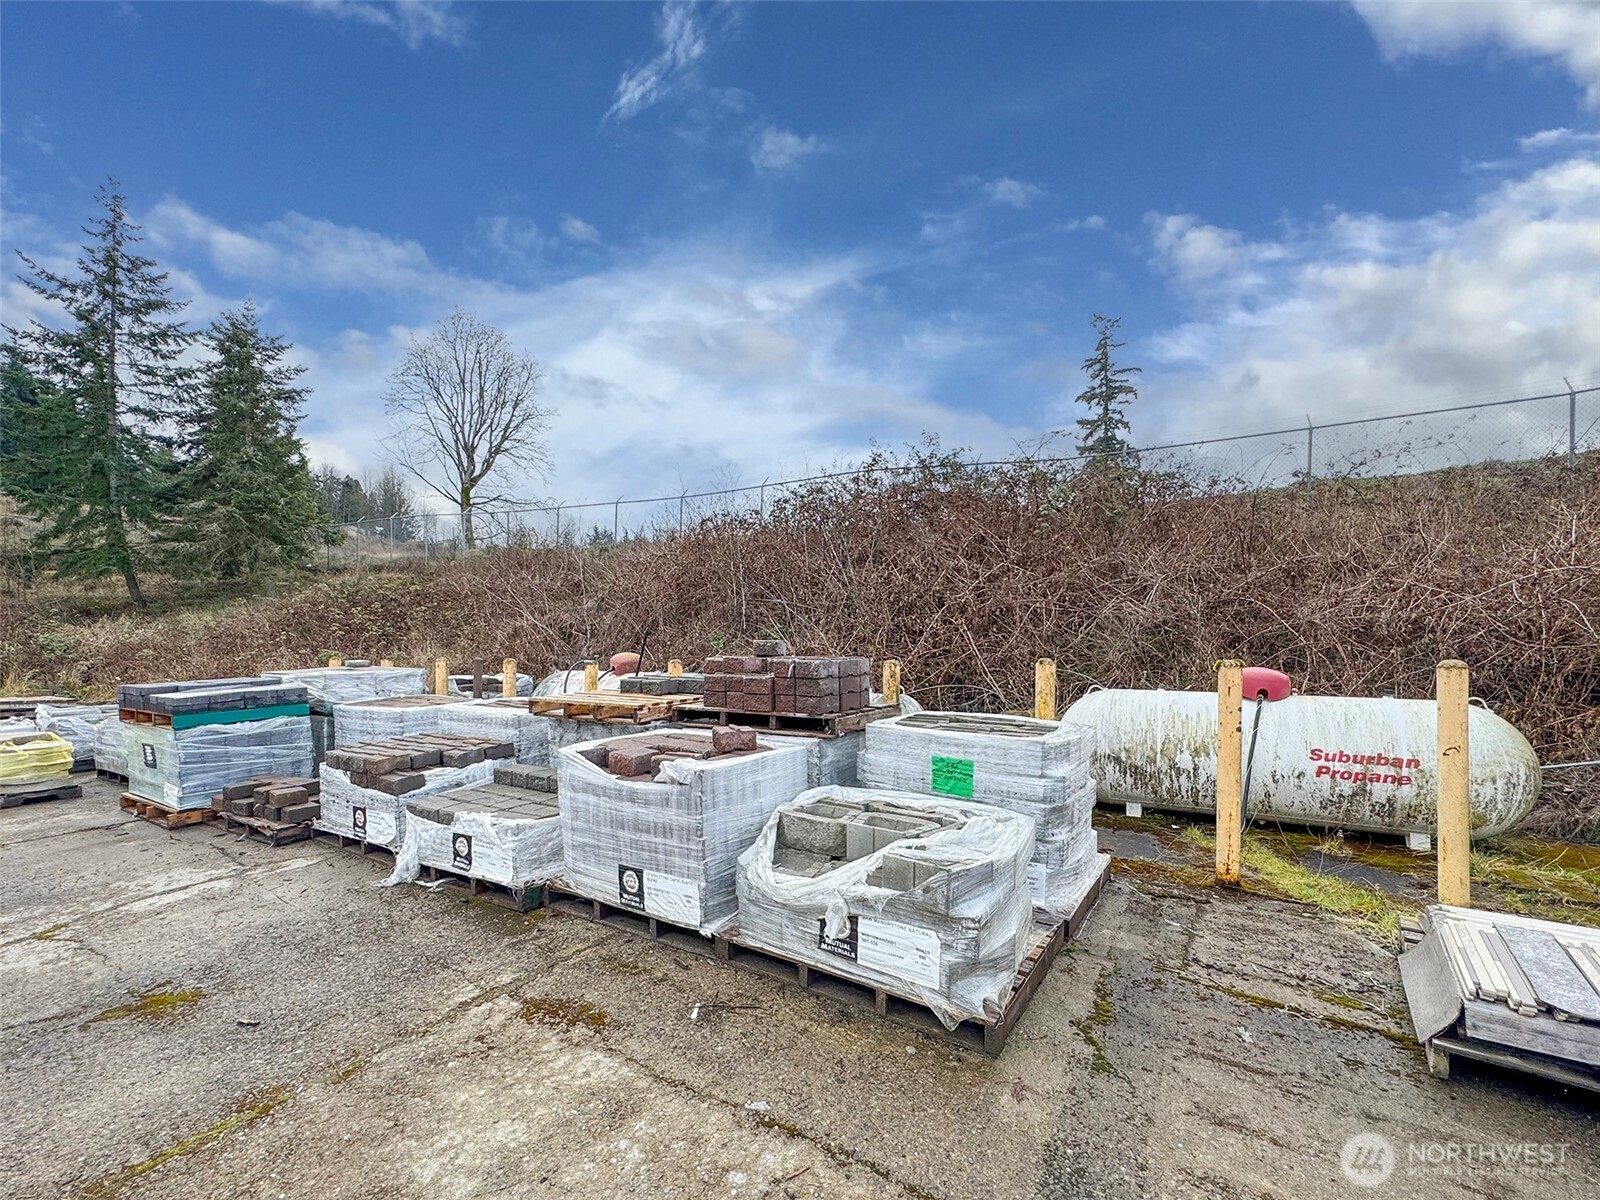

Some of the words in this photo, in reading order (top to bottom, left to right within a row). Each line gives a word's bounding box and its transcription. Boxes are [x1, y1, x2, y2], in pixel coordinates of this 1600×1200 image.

[1309, 748, 1421, 769] Suburban
[1315, 765, 1412, 786] Propane
[908, 927, 933, 939] NATURAL
[820, 942, 856, 959] MATERIALS
[825, 938, 852, 951] MUTUAL
